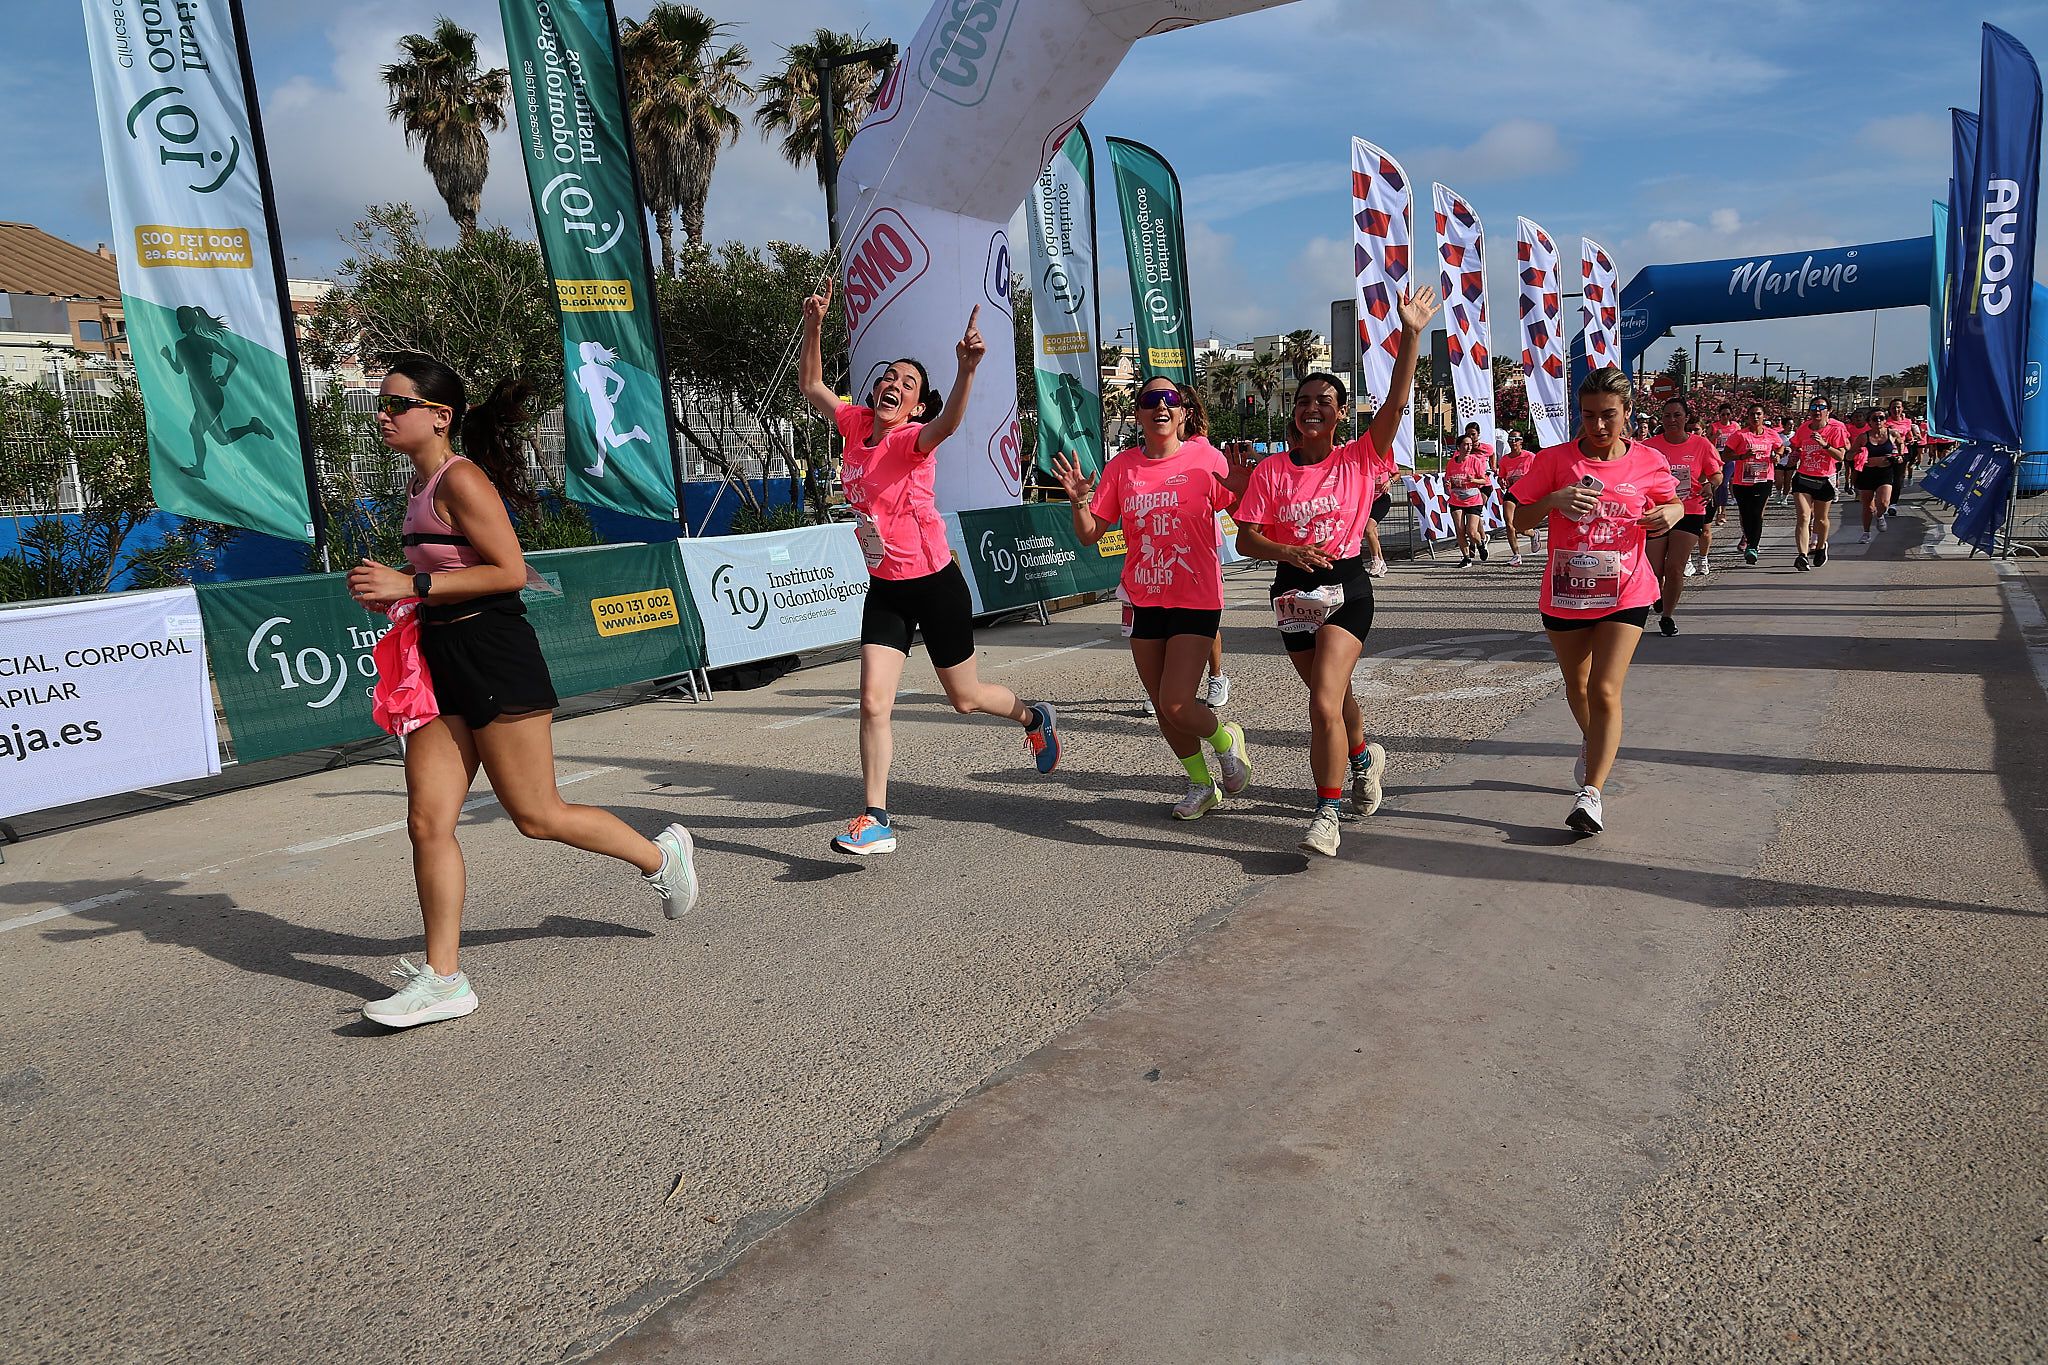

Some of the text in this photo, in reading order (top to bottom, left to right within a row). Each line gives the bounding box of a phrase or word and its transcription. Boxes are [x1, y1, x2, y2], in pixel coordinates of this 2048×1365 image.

[929, 0, 1000, 87] COS
[1728, 255, 1858, 310] Marlene
[1620, 316, 1646, 329] arlene
[1152, 513, 1171, 536] DE
[1315, 518, 1335, 543] DE
[1594, 522, 1615, 543] DE
[1151, 551, 1164, 568] LA
[766, 566, 835, 589] Institutos
[1134, 566, 1173, 586] MUJER
[1570, 577, 1597, 588] 016
[598, 595, 671, 617] 900 131 002
[773, 580, 869, 610] Odontológicos
[602, 609, 674, 630] www.ioa.es
[1296, 607, 1322, 617] 016
[0, 637, 193, 677] CIAL, CORPORAL
[0, 720, 102, 762] aja.es
